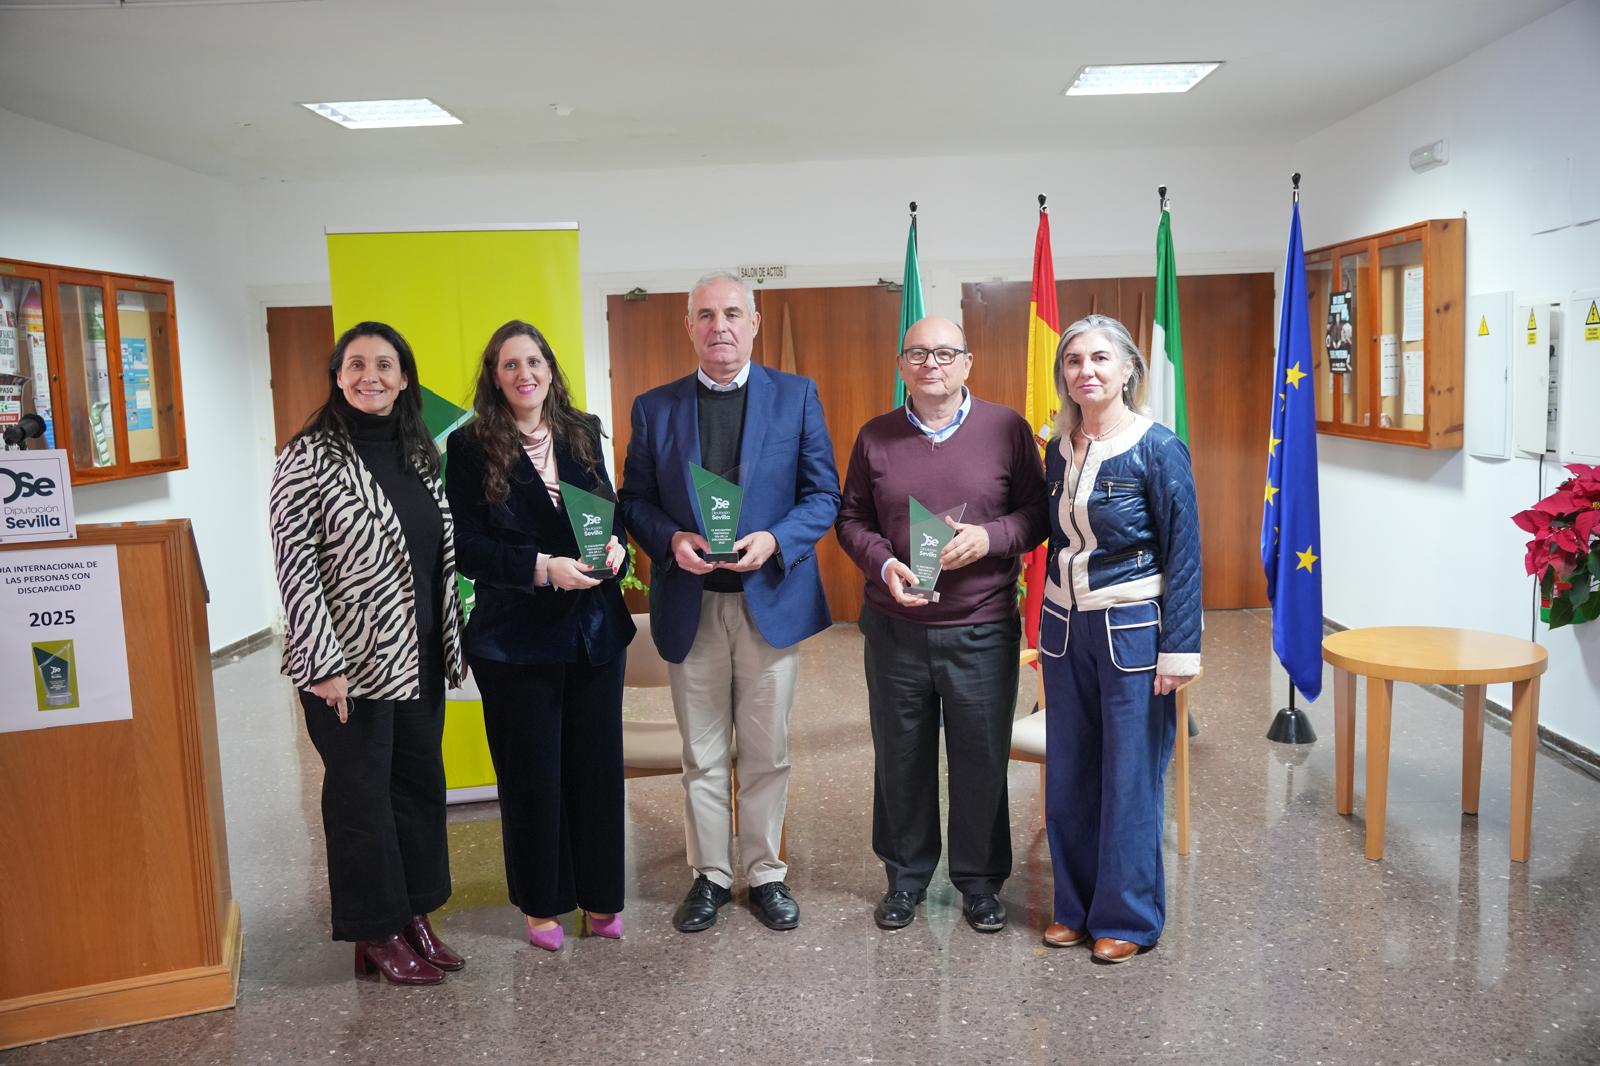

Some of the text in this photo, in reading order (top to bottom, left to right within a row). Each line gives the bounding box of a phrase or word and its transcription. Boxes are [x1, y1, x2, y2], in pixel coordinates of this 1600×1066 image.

[759, 267, 766, 278] DE
[766, 266, 784, 277] ACTOS
[4, 504, 59, 517] Diputación
[6, 514, 61, 529] Sevilla
[919, 550, 937, 558] Sevilla
[14, 562, 85, 573] INTERNACIONAL
[5, 572, 91, 585] LAS PERSONAS CON
[17, 583, 82, 595] DISCAPACIDAD
[29, 610, 76, 627] 2025
